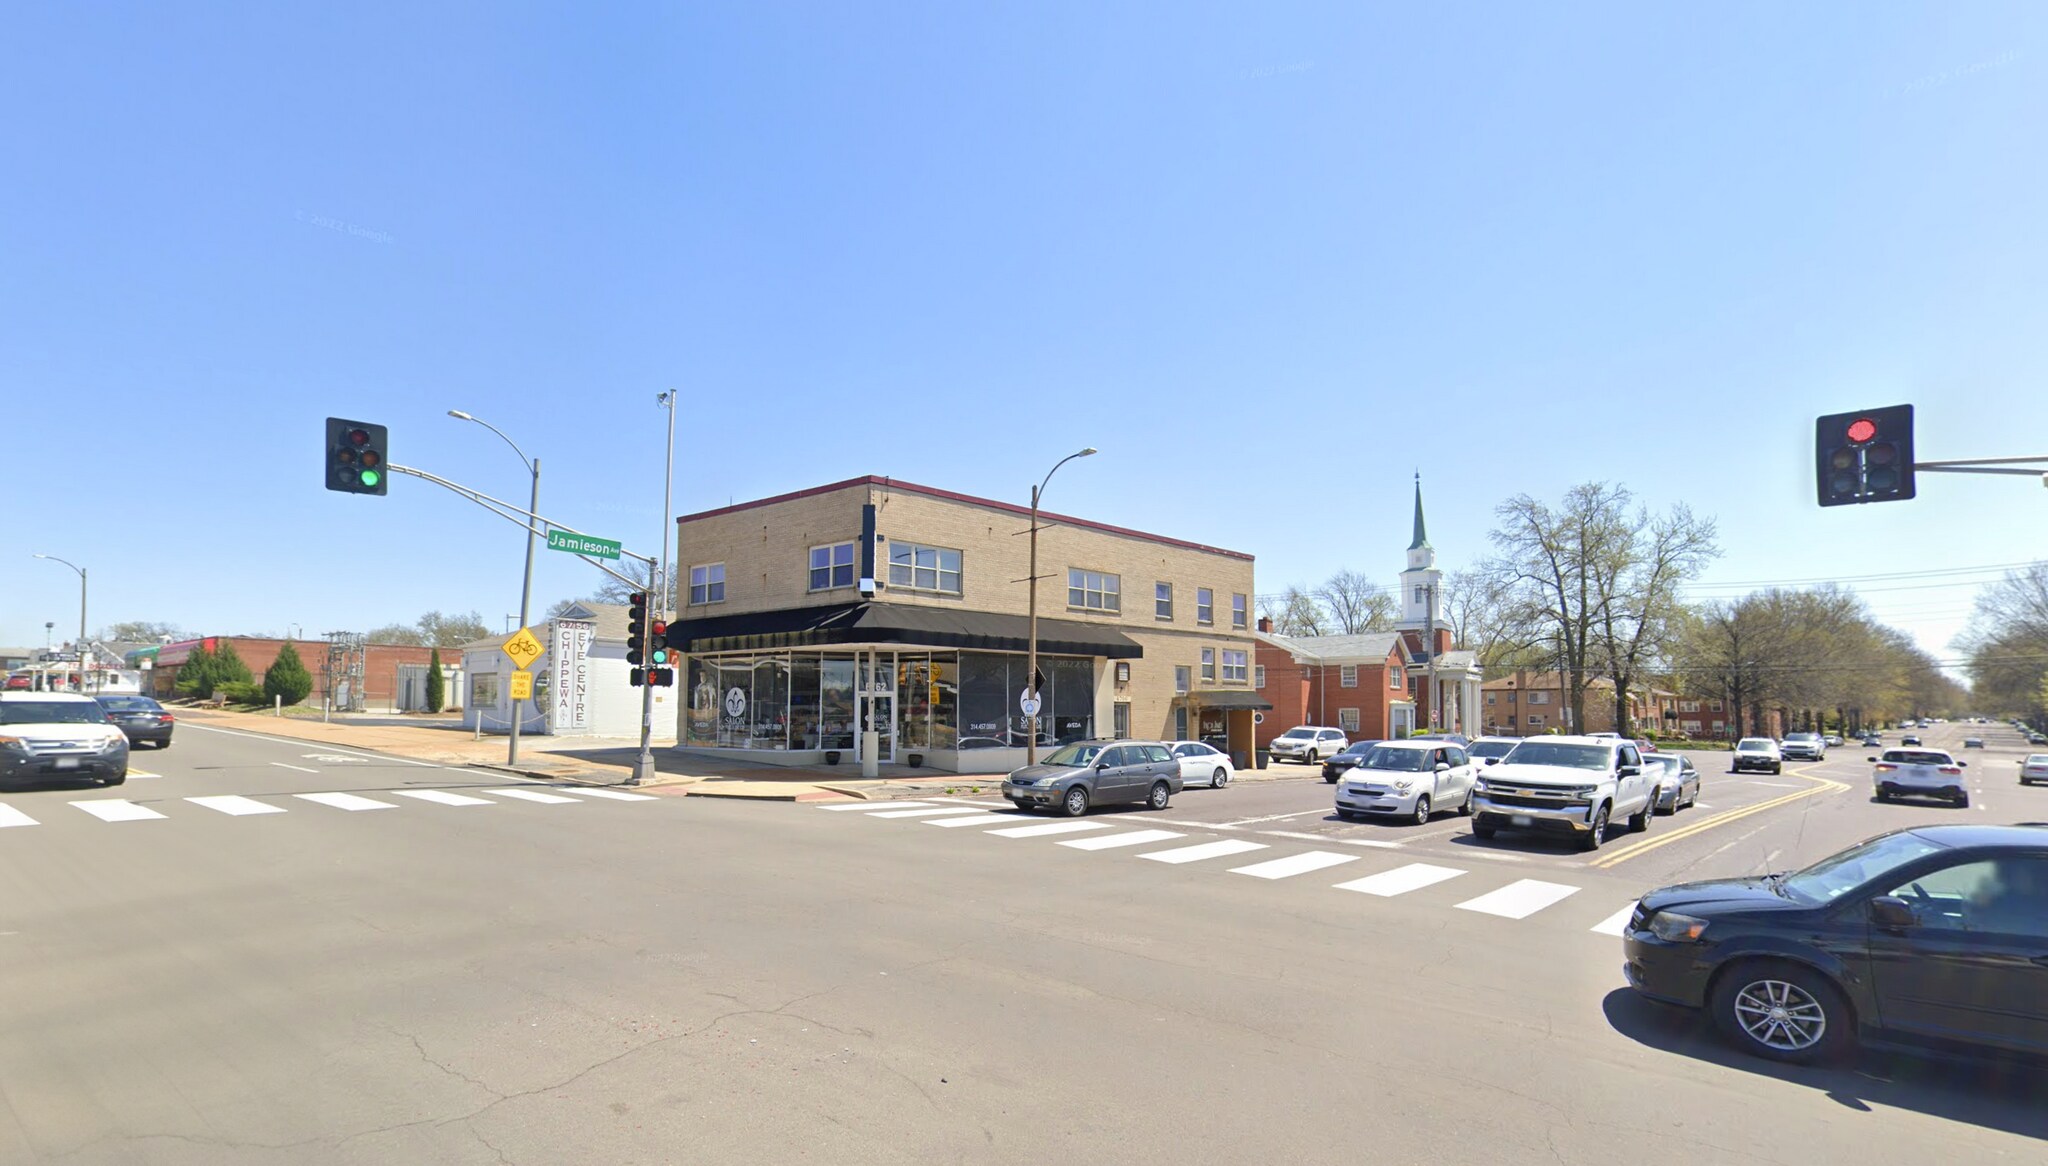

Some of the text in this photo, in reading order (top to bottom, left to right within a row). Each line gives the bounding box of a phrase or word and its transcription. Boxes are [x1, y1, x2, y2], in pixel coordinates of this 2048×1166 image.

[549, 534, 609, 555] Jamieson
[560, 622, 589, 630] 6756
[560, 631, 570, 708] CHIPPEWA
[576, 632, 587, 721] EYE CENTRE
[866, 682, 886, 691] 662
[725, 716, 745, 724] SALON
[1021, 716, 1042, 725] SAN
